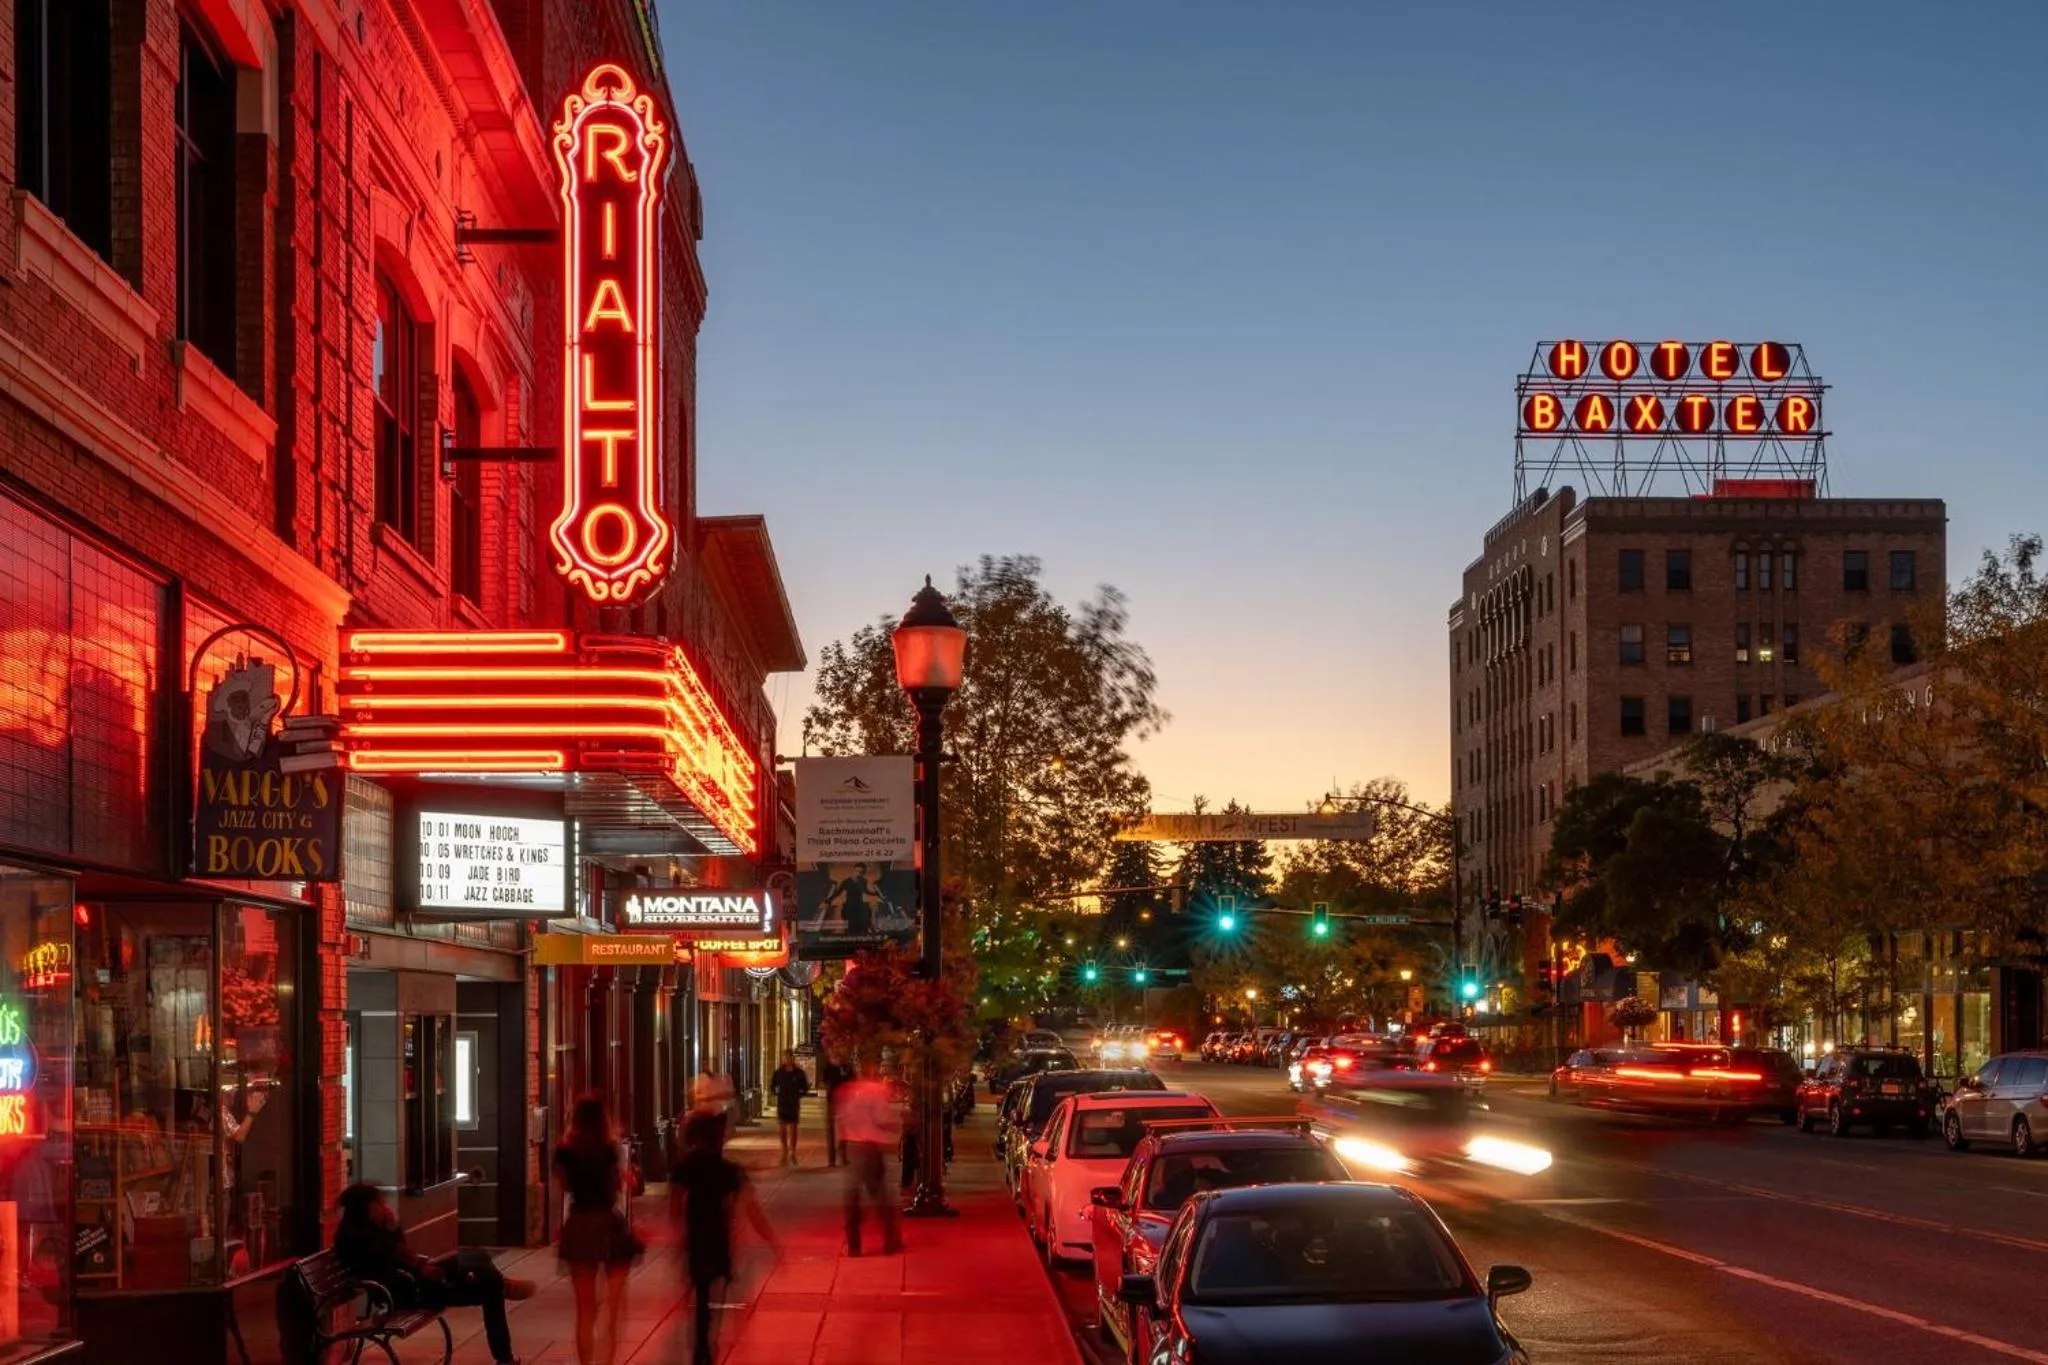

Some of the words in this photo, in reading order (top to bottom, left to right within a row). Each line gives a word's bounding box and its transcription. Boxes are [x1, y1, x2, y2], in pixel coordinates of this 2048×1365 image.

[582, 123, 638, 565] RIALTO
[1558, 340, 1783, 379] HOTEL
[1533, 394, 1809, 432] BAXTER
[218, 810, 257, 828] JAZZ
[262, 810, 297, 829] CITY
[454, 823, 482, 839] MOON
[489, 825, 520, 842] HOOCH
[207, 835, 323, 877] BOOKS
[454, 845, 503, 861] WRETCHES
[506, 847, 514, 862] &
[519, 848, 549, 863] KINGS
[468, 866, 490, 881] JADE
[496, 867, 521, 882] BIRD
[464, 886, 488, 901] JAZZ
[492, 887, 534, 903] CABBAGE
[643, 896, 760, 913] MONTANA
[643, 915, 760, 923] SILVERSMITHS
[591, 943, 667, 956] RESTAURANT
